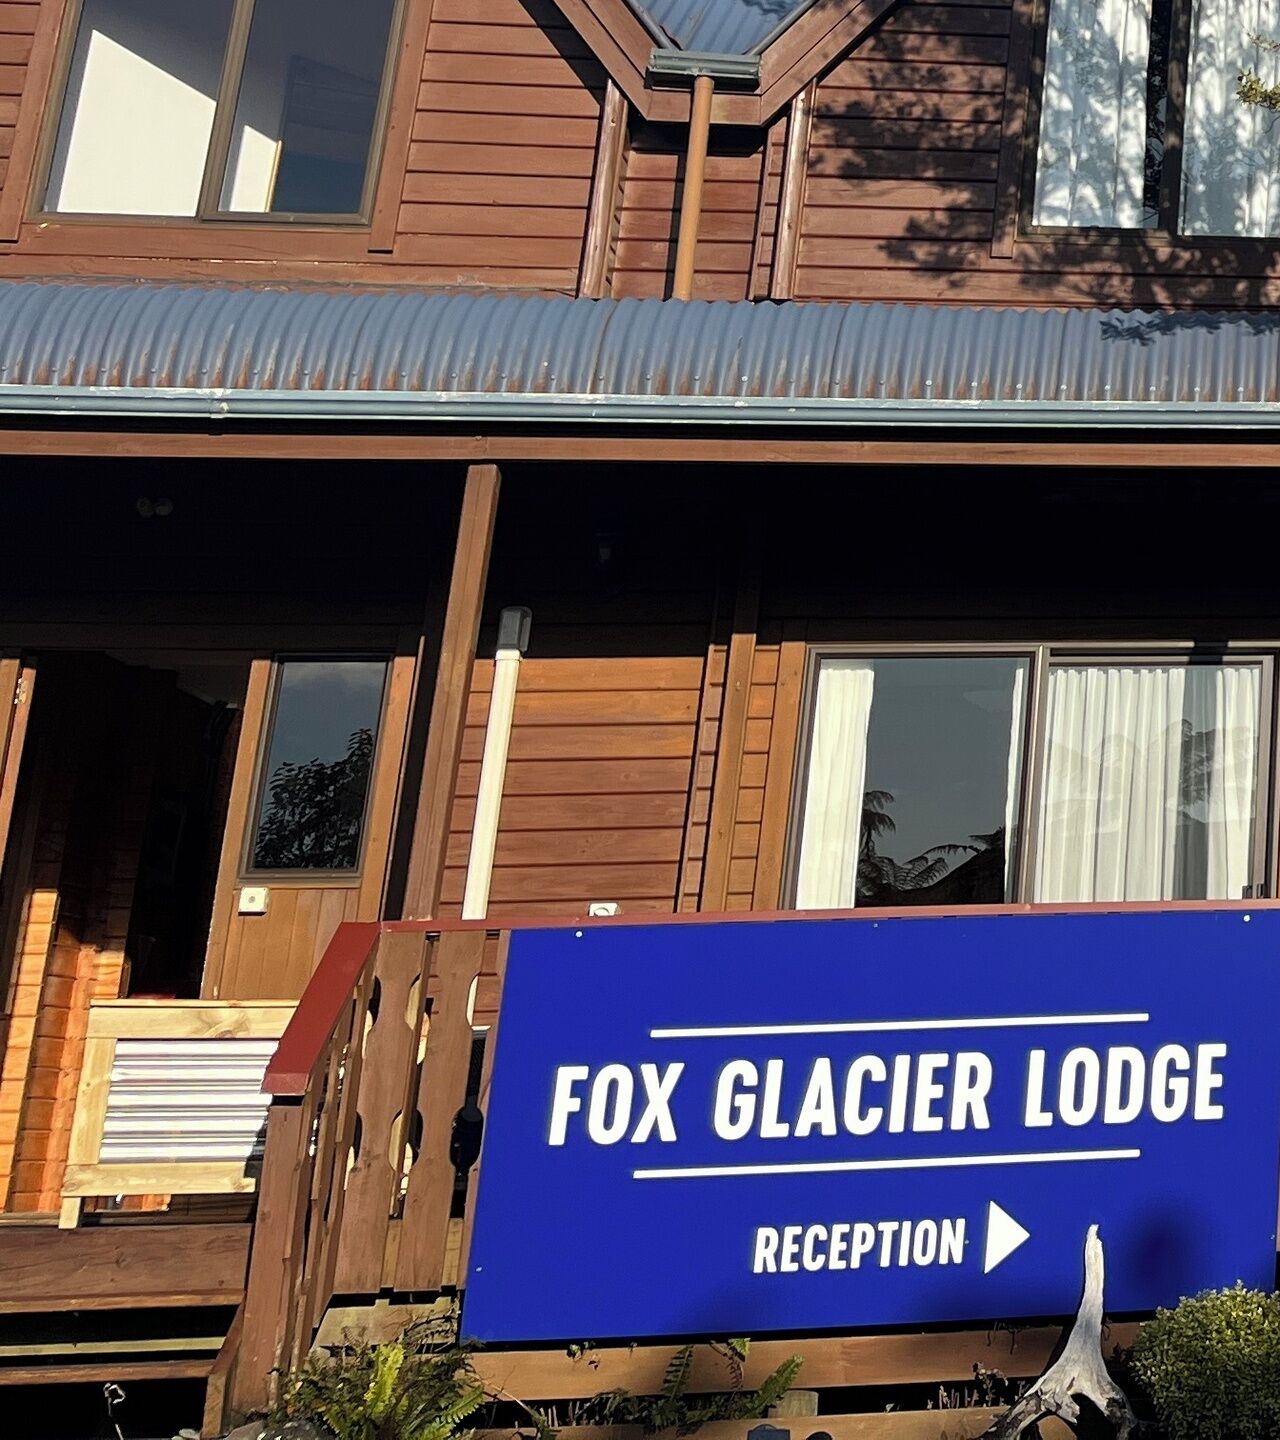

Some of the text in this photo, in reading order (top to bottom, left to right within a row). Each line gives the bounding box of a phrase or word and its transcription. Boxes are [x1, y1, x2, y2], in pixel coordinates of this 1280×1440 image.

[549, 1043, 1228, 1146] FOX GLACIER LODGE
[752, 1217, 966, 1274] RECEPTION
